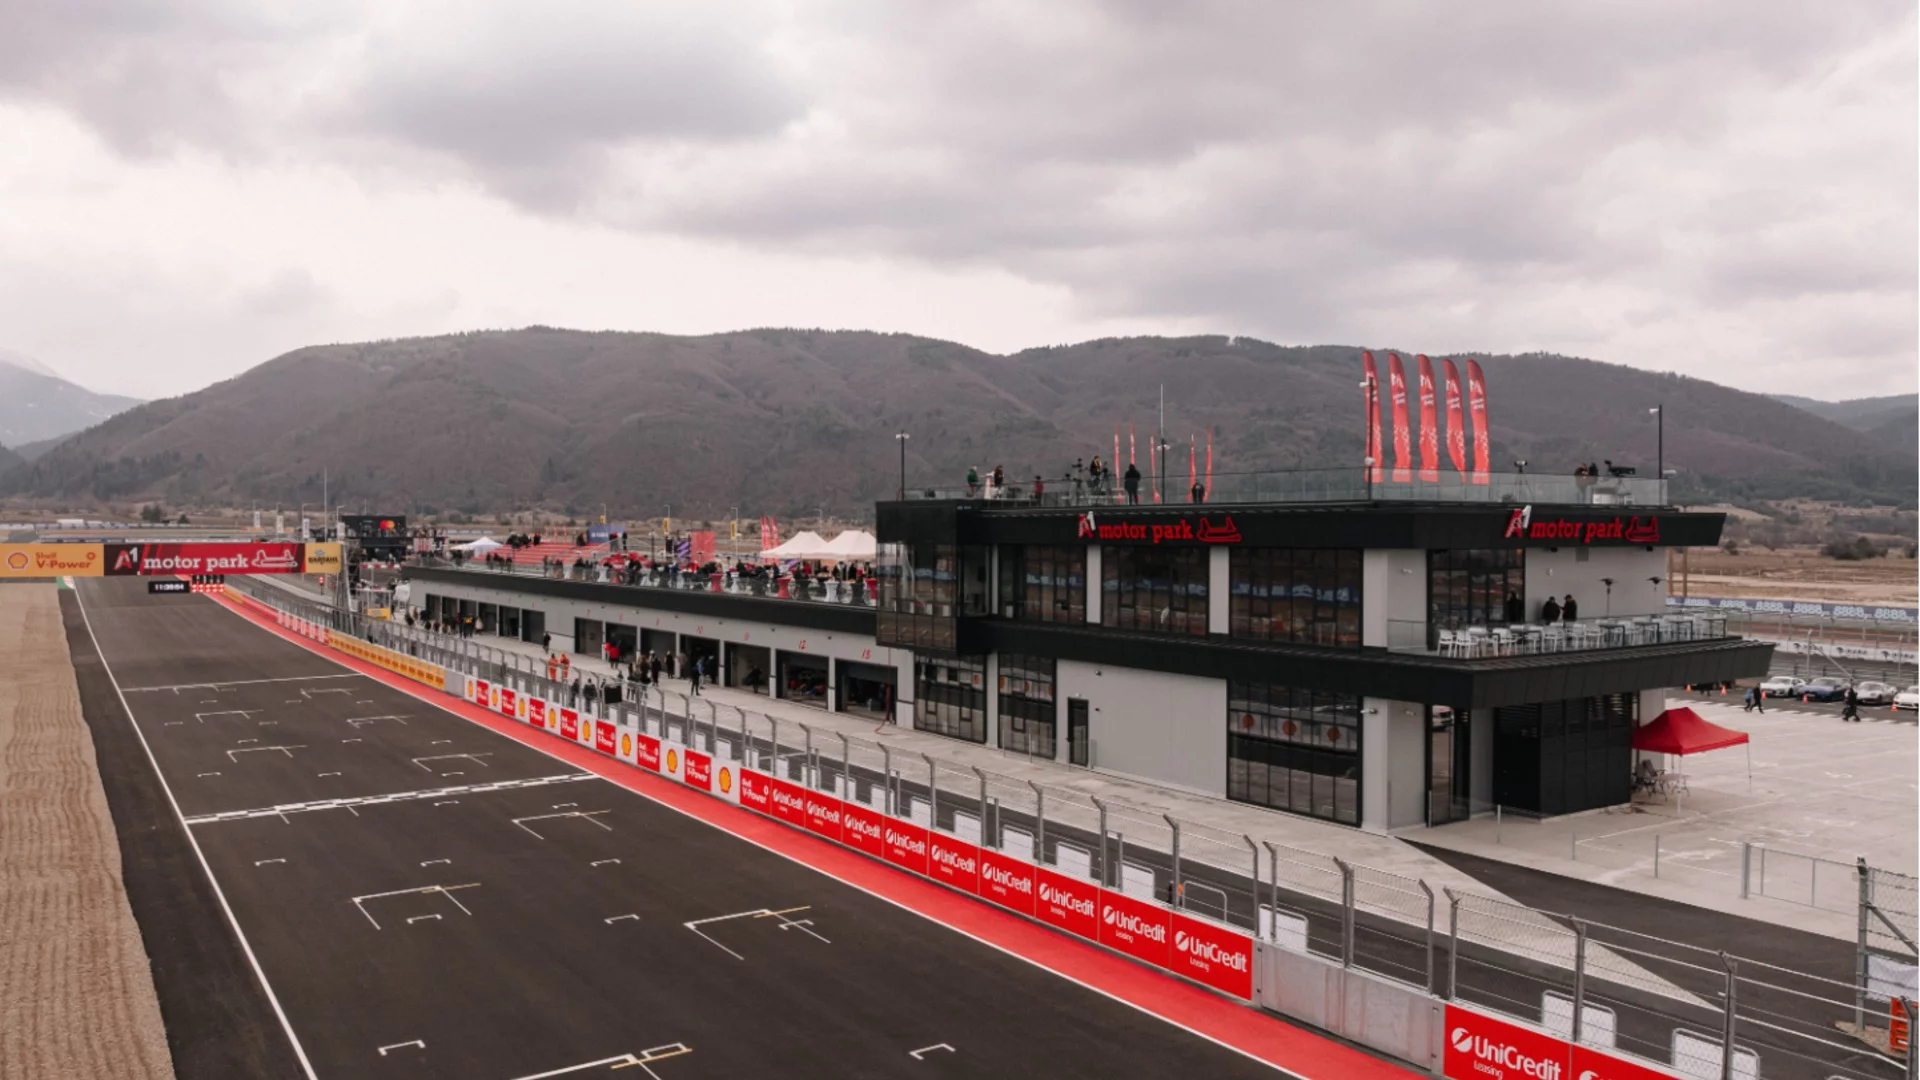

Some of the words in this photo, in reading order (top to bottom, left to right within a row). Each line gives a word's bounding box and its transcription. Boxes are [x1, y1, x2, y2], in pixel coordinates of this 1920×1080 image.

[1078, 510, 1096, 539] A1
[1098, 521, 1147, 539] motor
[1151, 519, 1194, 544] park
[1504, 504, 1532, 538] A1
[1529, 518, 1582, 539] motor
[1584, 516, 1624, 543] park
[36, 559, 92, 569] V-Power
[113, 547, 139, 570] A1
[143, 555, 200, 569] motor
[206, 553, 248, 572] park
[851, 816, 881, 839] UniCredit
[893, 831, 926, 855] UniCredit
[940, 846, 976, 875] UniCredit
[991, 868, 1032, 895] UniCredit
[1049, 888, 1095, 918] UniCredit
[1116, 911, 1166, 944] UniCredit
[1190, 935, 1247, 973] UniCredit
[1190, 956, 1210, 972] Leasing
[1473, 1059, 1504, 1080] Leasing
[1474, 1035, 1561, 1080] UniCredit
